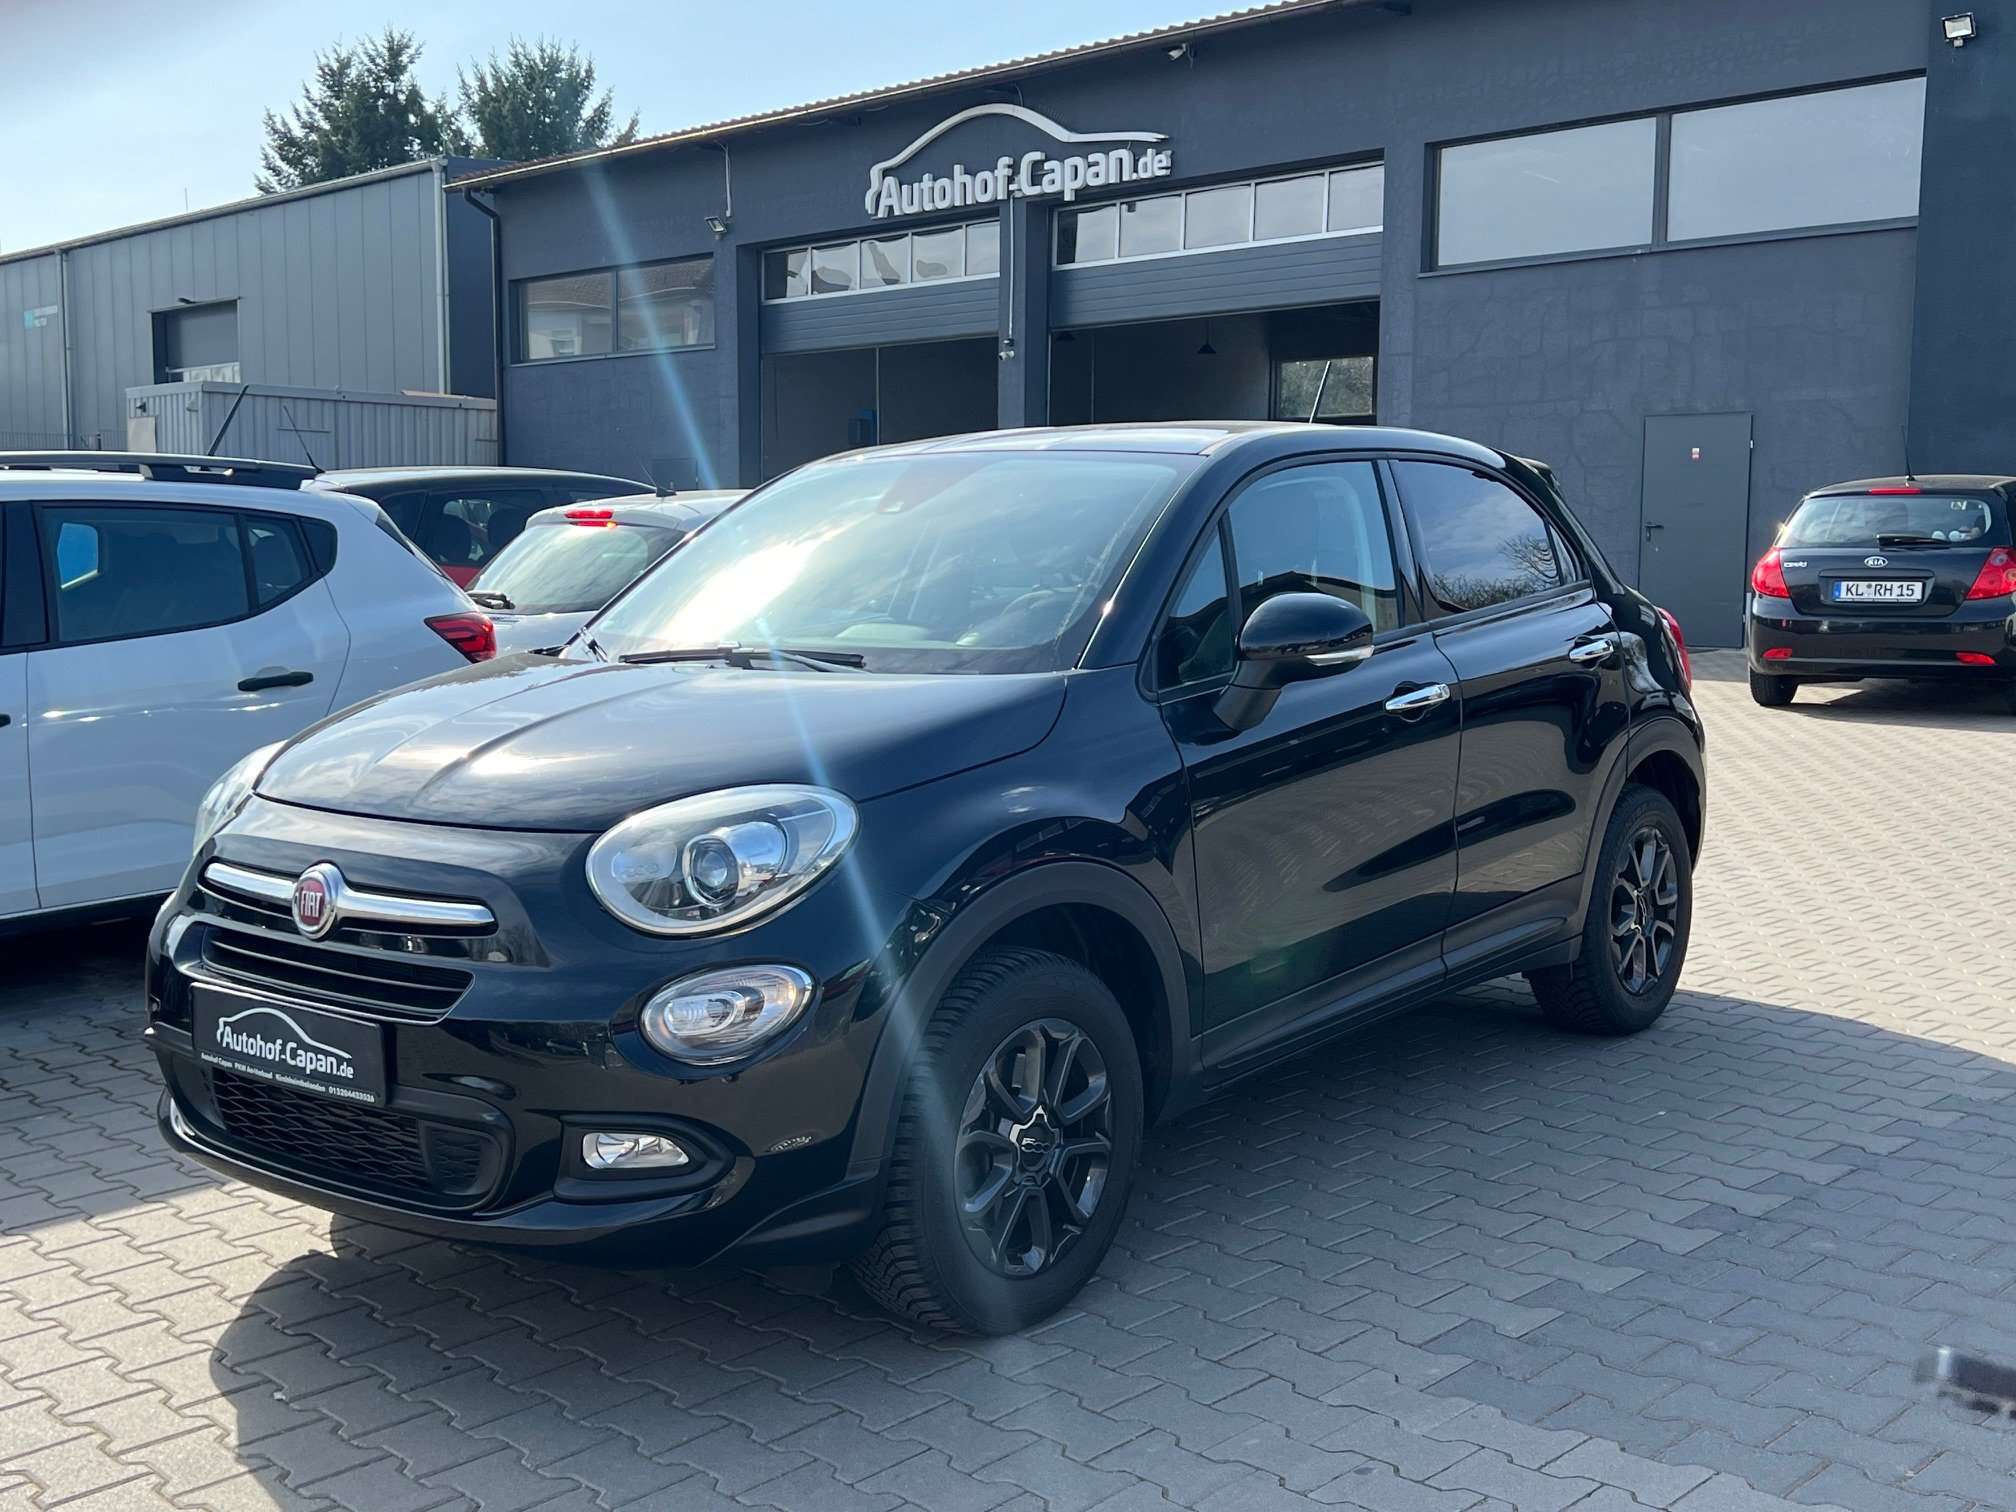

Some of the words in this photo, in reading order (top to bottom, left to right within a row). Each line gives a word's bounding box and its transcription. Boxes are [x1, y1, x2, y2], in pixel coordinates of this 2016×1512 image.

[1846, 583, 1864, 597] KL
[1874, 583, 1893, 597] RH
[1897, 583, 1916, 597] 15
[301, 890, 323, 918] FIAT
[222, 1025, 354, 1079] Autohof-Capan.de
